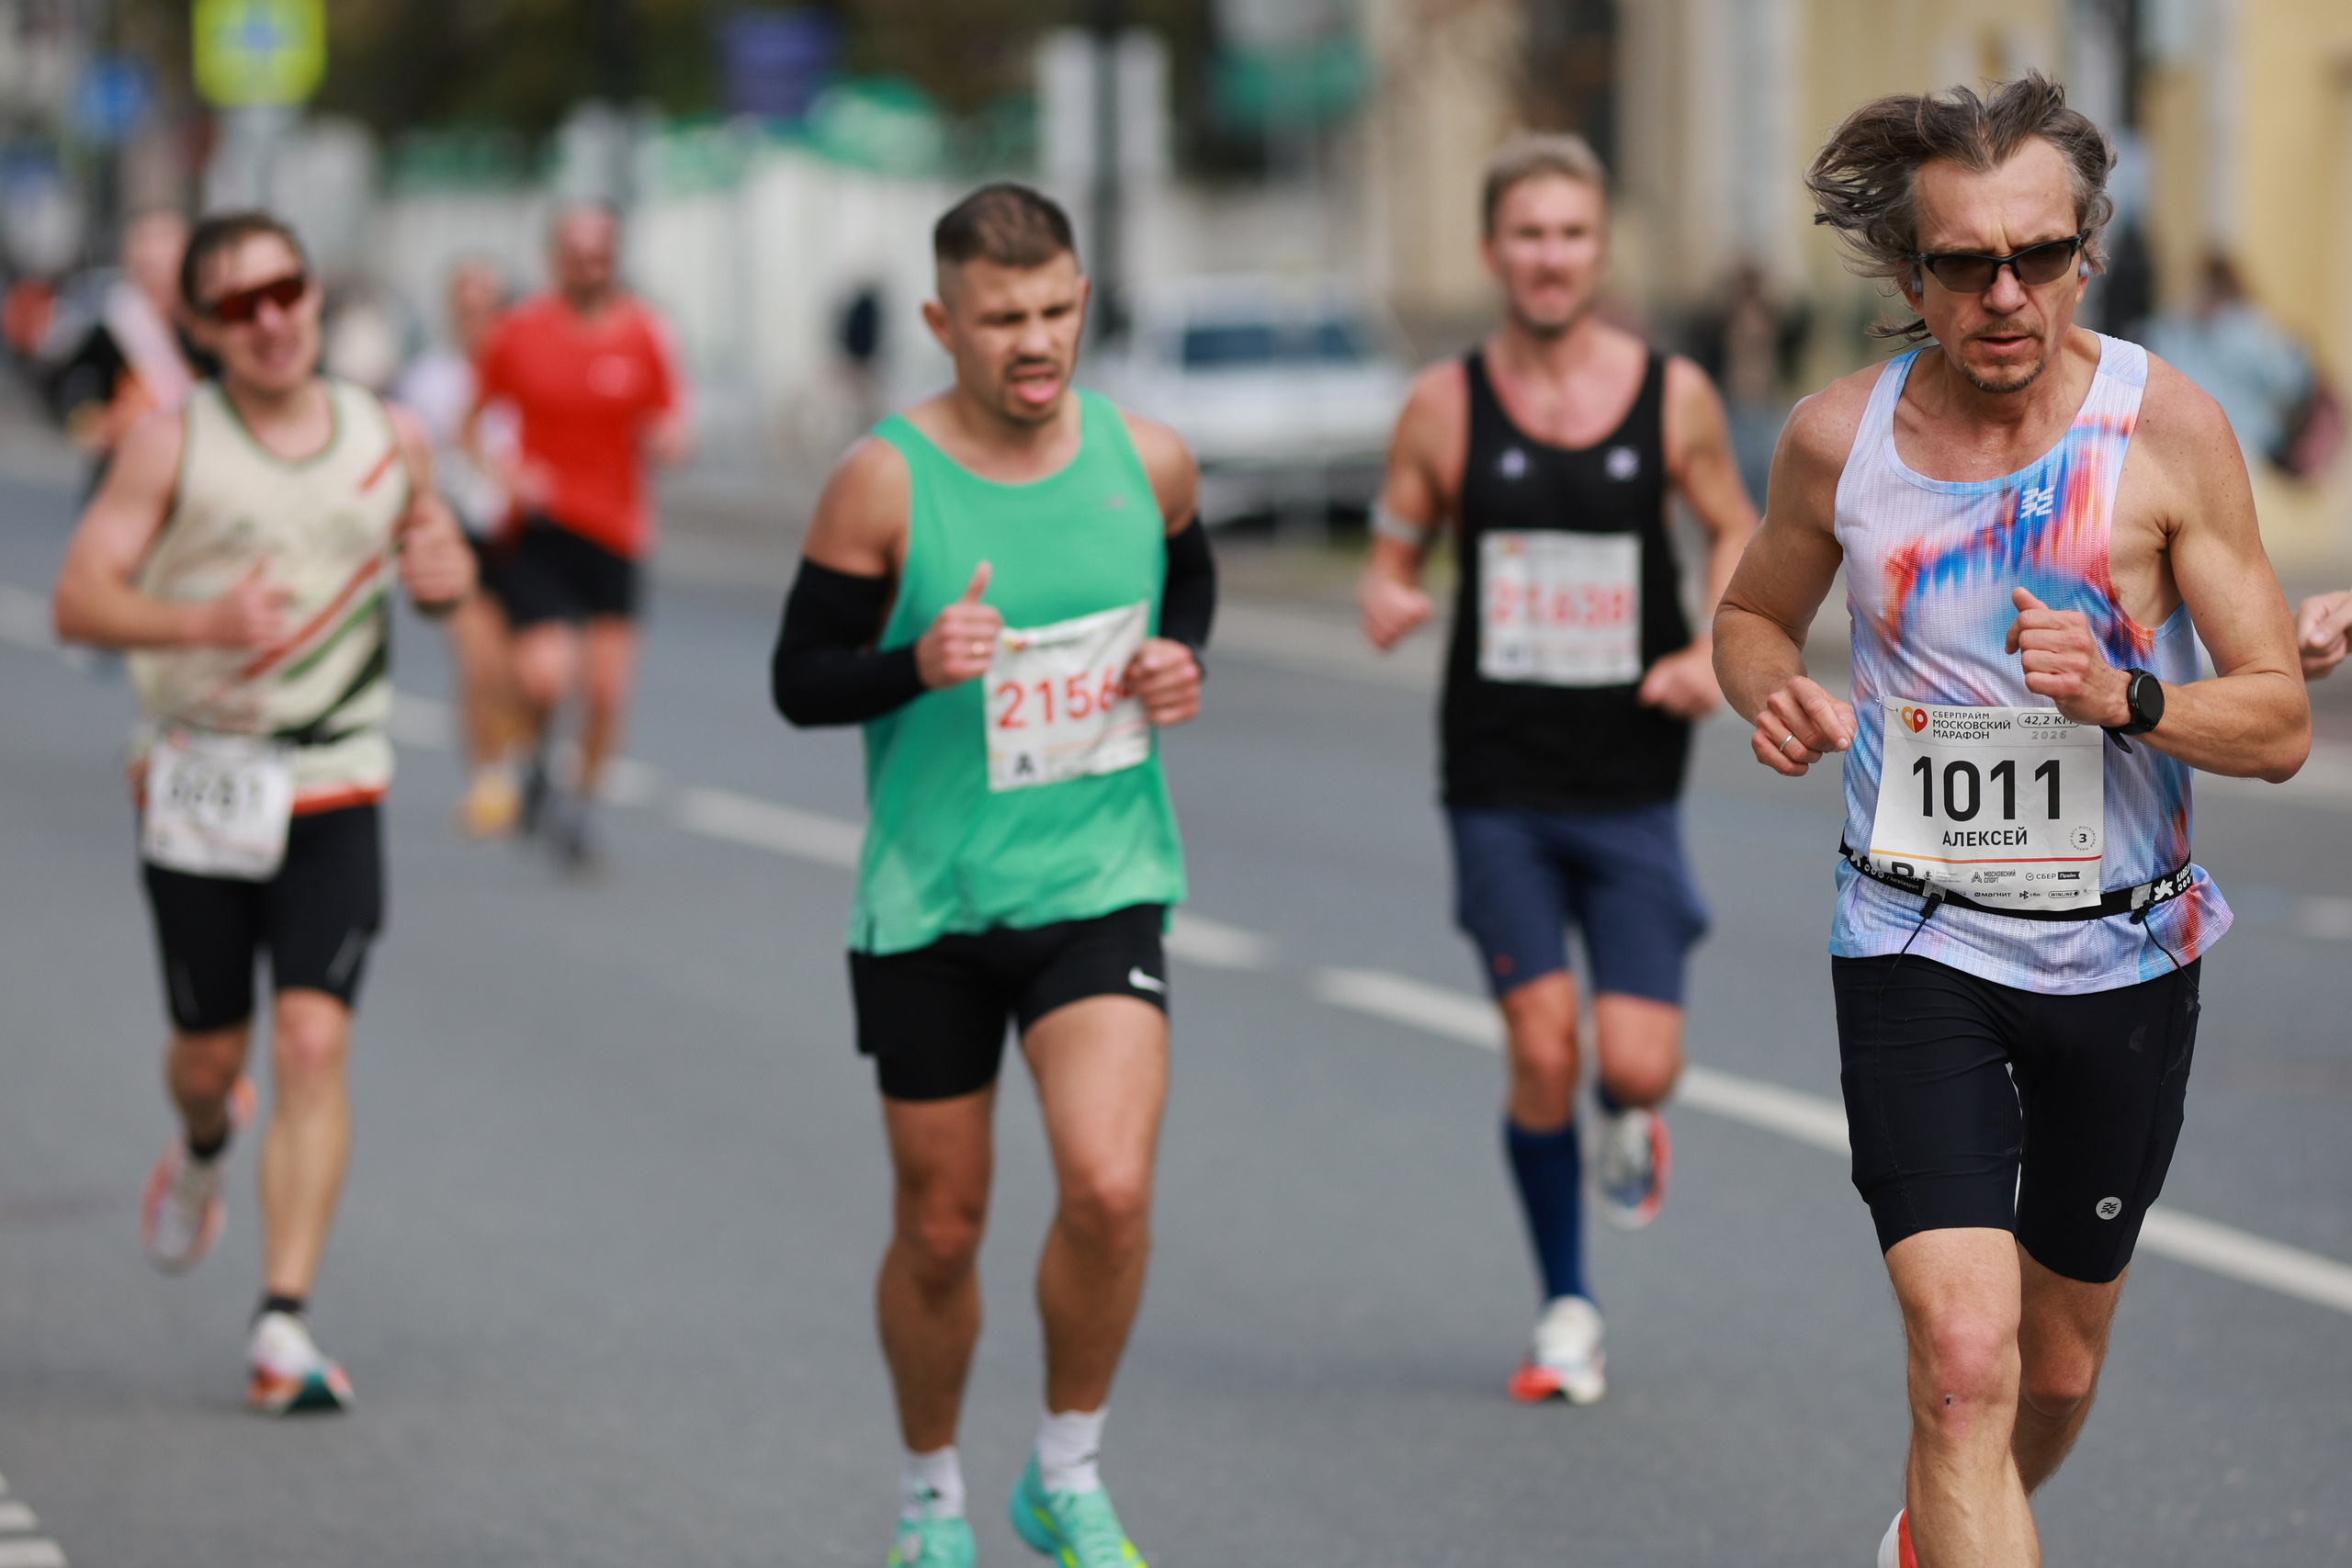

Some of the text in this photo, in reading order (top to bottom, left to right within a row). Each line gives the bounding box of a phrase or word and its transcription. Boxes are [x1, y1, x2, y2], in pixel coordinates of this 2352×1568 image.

[1932, 710, 1990, 720] СБЕРПРАЙМ
[1932, 719, 2011, 729] МОСКОВСКИЙ
[2024, 716, 2050, 726] 42,2
[1932, 729, 1990, 739] МАРАФОН
[2031, 730, 2067, 740] 2026
[1913, 755, 2060, 822] 1011
[1942, 827, 2028, 847] АЛЕКСЕЙ
[2078, 833, 2087, 843] 3
[1984, 869, 2017, 877] МОСКОВСКИЙ
